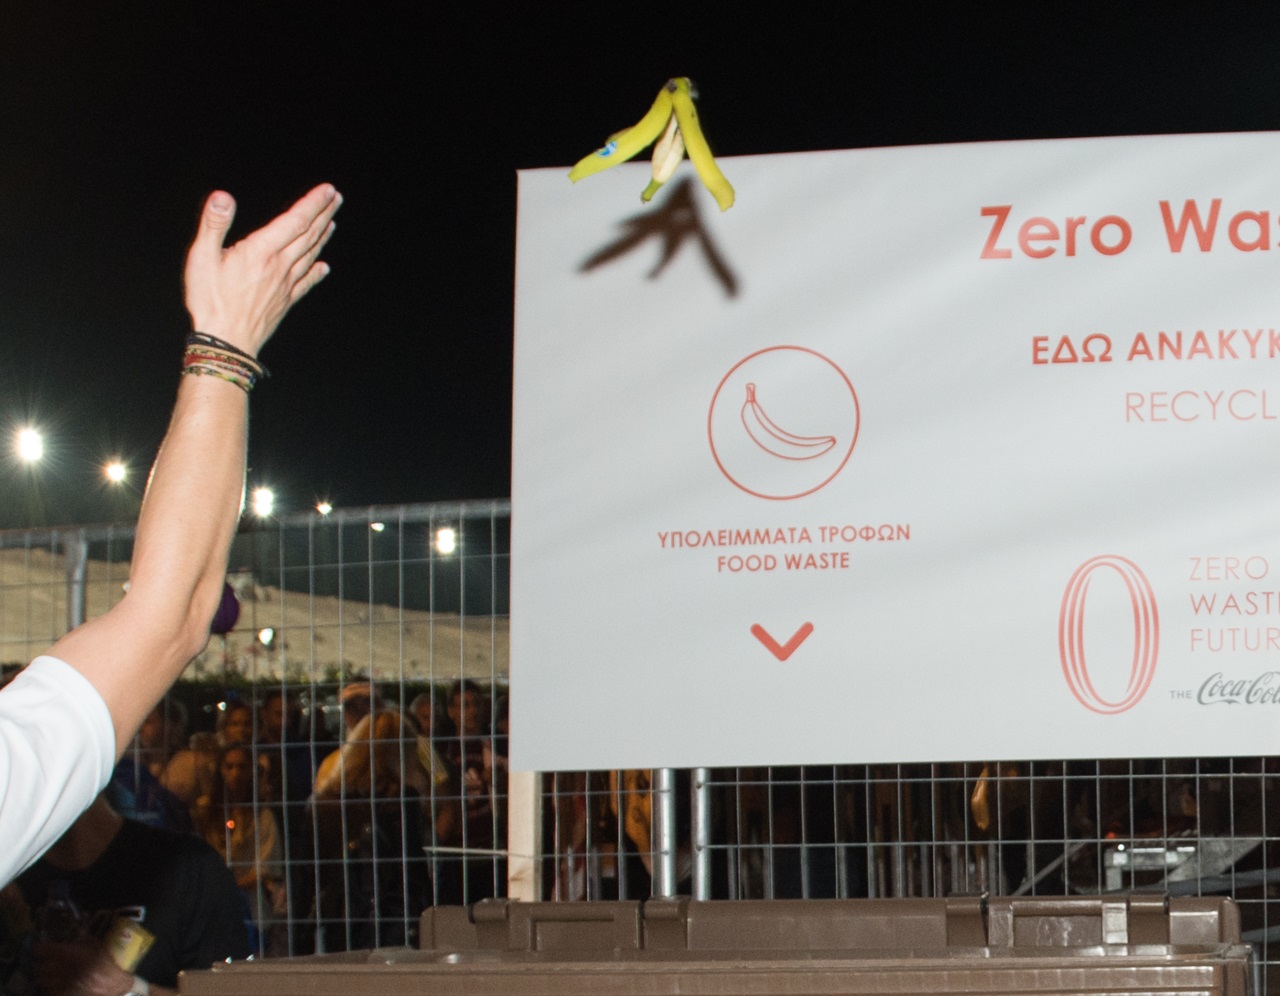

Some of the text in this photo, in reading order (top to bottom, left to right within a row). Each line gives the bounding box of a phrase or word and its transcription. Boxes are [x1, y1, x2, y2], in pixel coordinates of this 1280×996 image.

[979, 204, 1133, 260] Zero
[1032, 332, 1113, 366] ΕΔΩ
[657, 523, 912, 549] ΥΠΟΛΕΙΜΜΑΤΑ ΤΡΟΦΩΝ
[717, 551, 850, 573] FOOD WASTE
[1187, 555, 1271, 582] ZERO
[1169, 690, 1193, 700] THE
